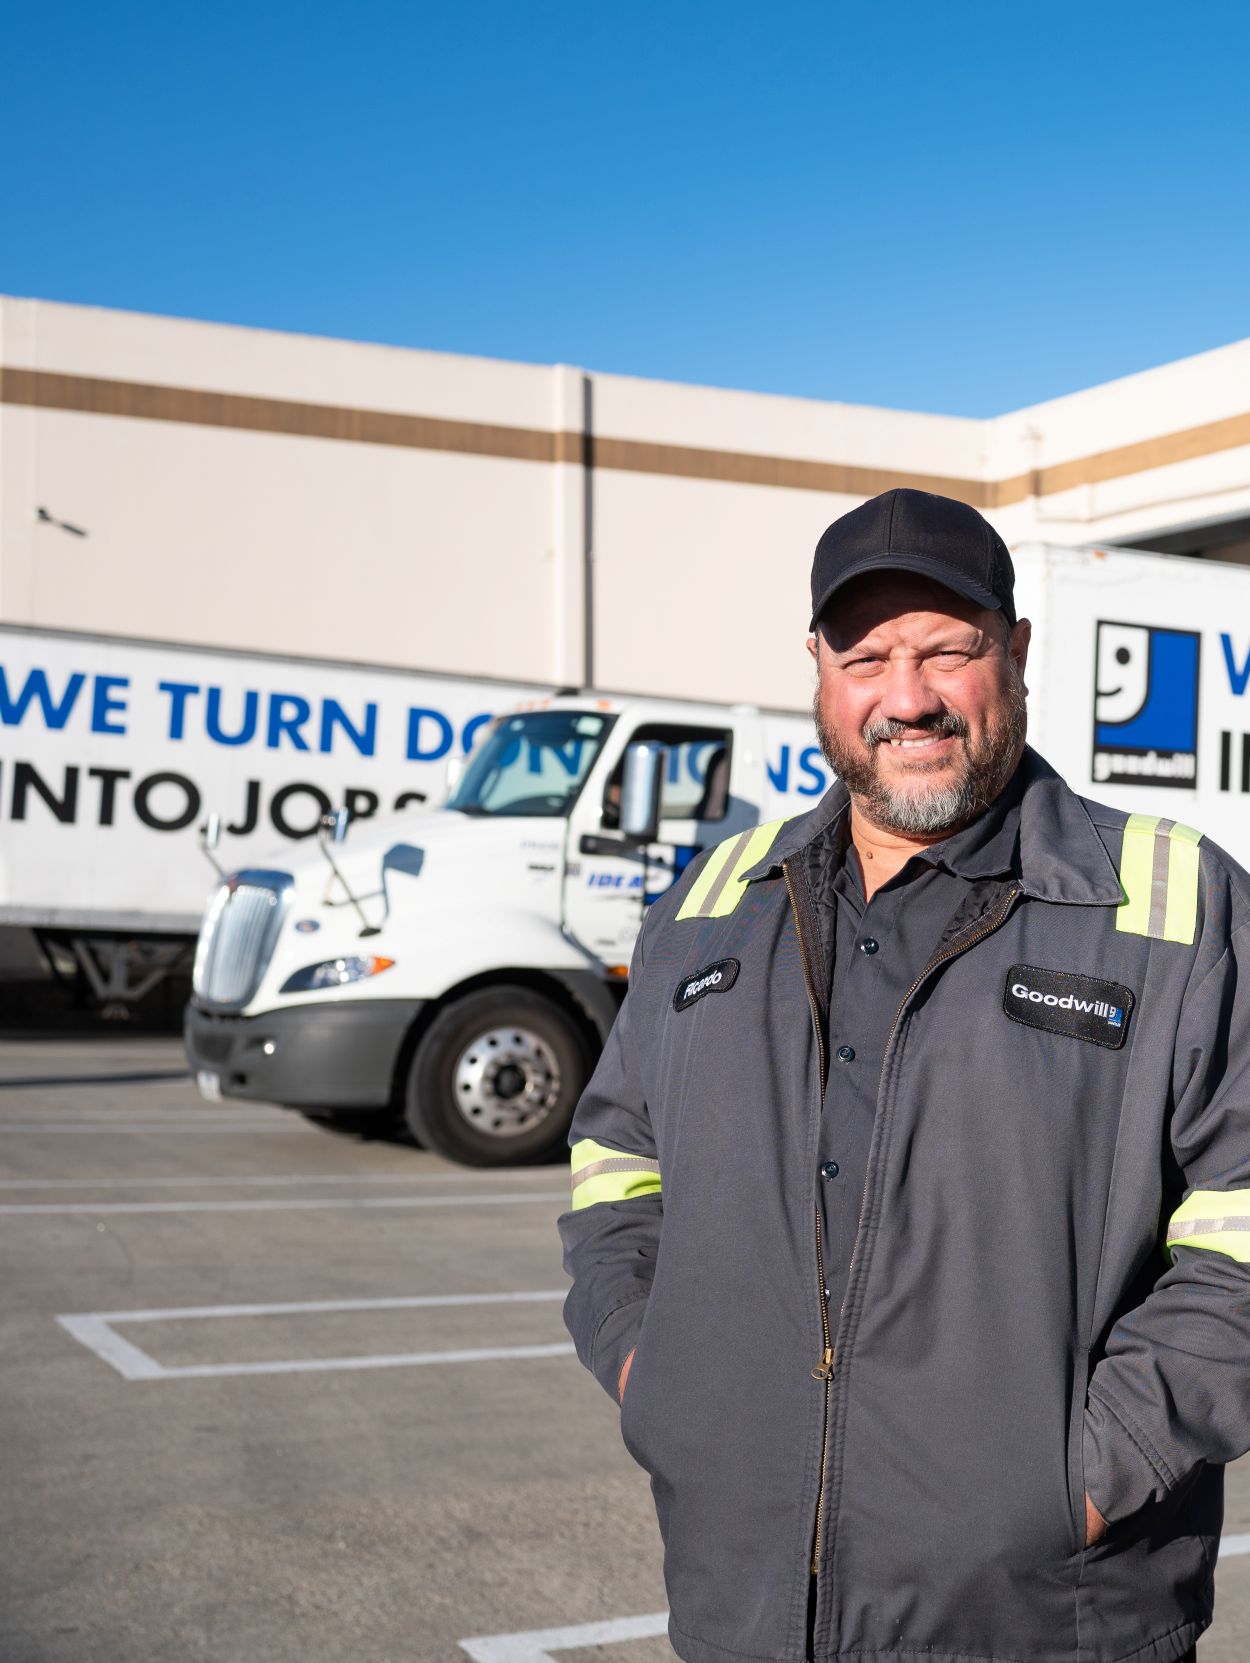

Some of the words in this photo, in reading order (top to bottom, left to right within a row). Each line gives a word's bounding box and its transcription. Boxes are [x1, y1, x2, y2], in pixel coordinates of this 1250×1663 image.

[0, 664, 130, 735] WE
[158, 682, 378, 757] TURN
[0, 759, 202, 831] NTO
[683, 970, 722, 1000] Ricardo
[1011, 983, 1109, 1018] Goodwill
